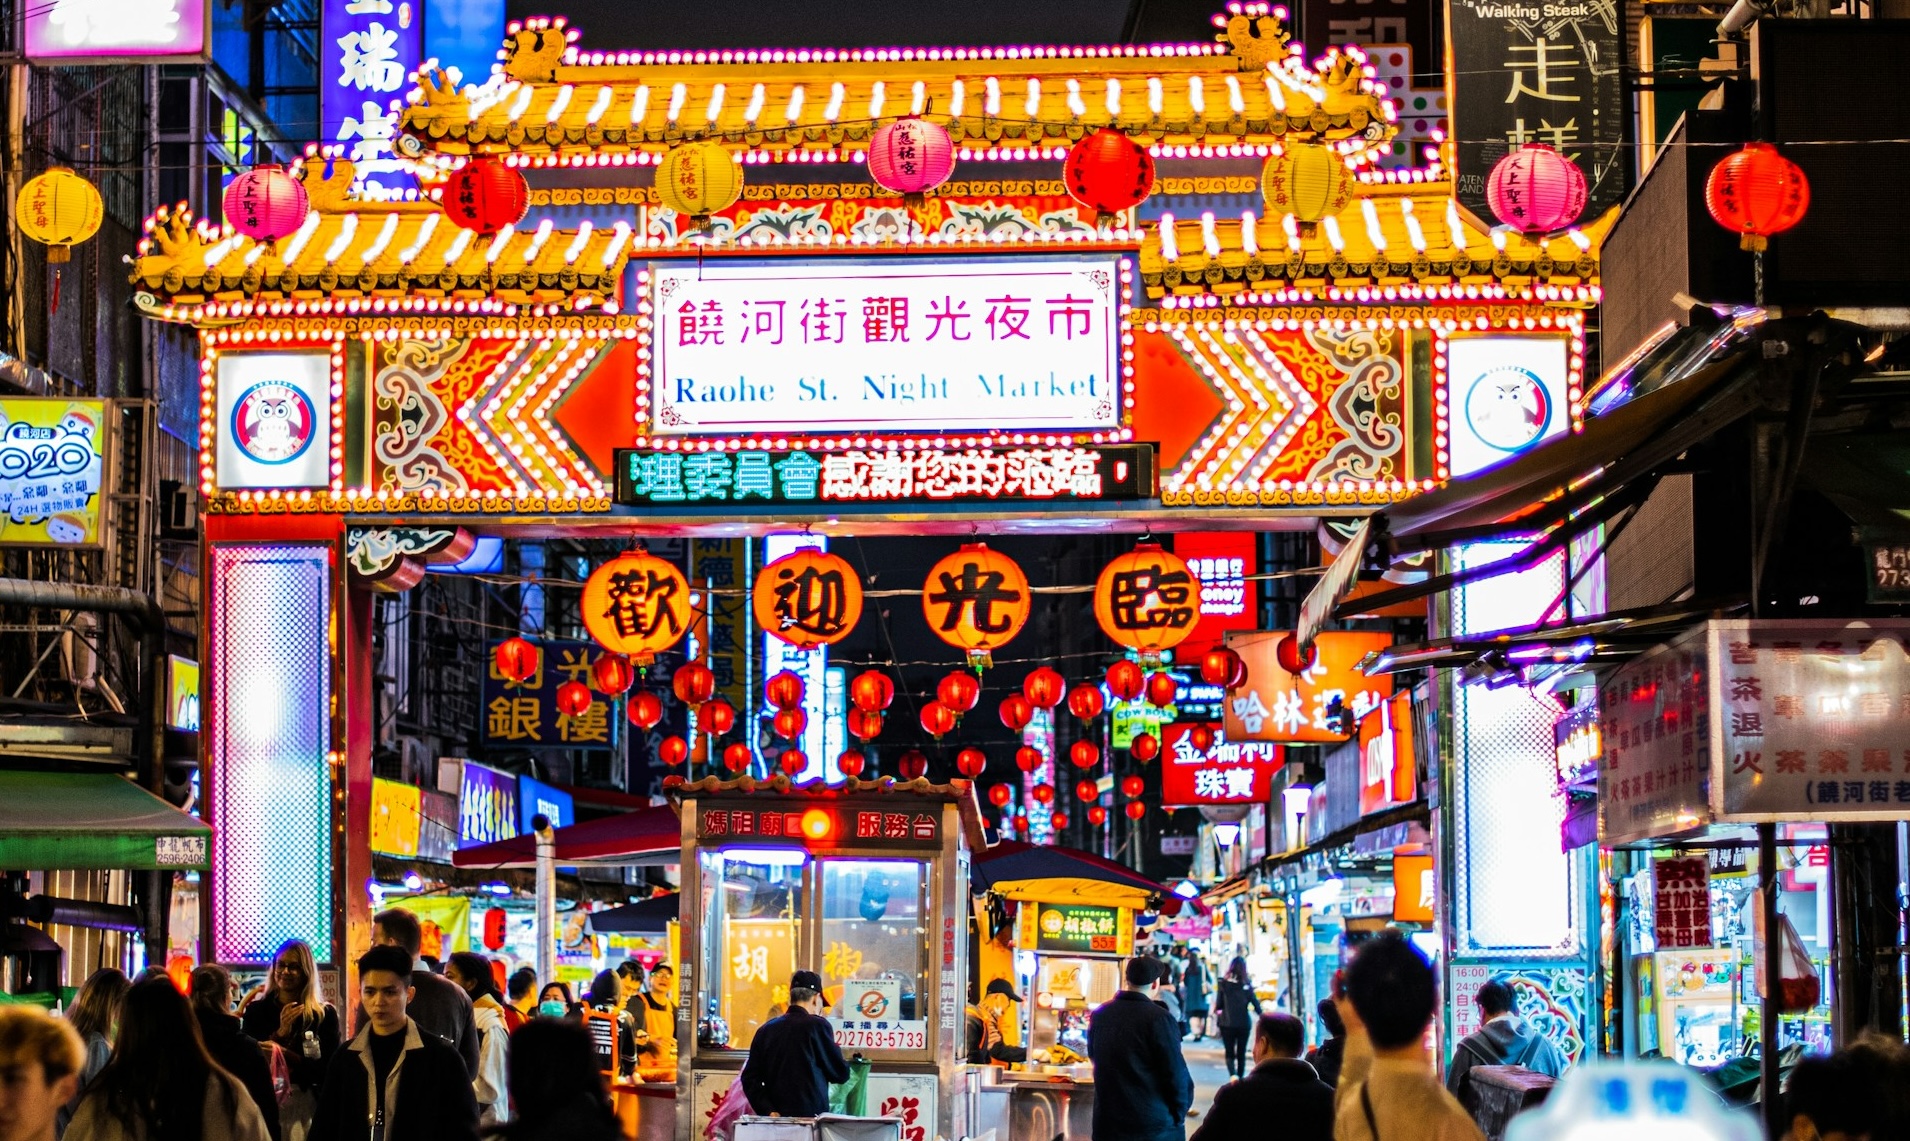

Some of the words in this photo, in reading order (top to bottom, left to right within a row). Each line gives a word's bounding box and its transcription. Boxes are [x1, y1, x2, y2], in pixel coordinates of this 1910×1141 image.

[1476, 4, 1539, 19] Walking
[1544, 4, 1588, 17] Steak
[243, 174, 260, 228] 天上聖母
[1506, 158, 1525, 218] 天上聖母
[678, 293, 1094, 346] 饒河街觀光夜市
[675, 375, 775, 403] Raohe
[799, 375, 838, 401] St.
[863, 374, 948, 405] Night
[977, 371, 1097, 398] Market
[19, 428, 51, 438] 饒河店
[17, 505, 38, 516] 24H
[1875, 549, 1910, 569] 龍門
[602, 569, 683, 640] 歡
[773, 564, 848, 634] 迎
[928, 562, 1022, 635] 光
[1109, 564, 1194, 631] 臨
[1200, 587, 1245, 604] oney
[1116, 709, 1141, 720] COW
[1145, 709, 1175, 720] BOSS
[1729, 640, 1764, 776] 苦茶退火
[1773, 640, 1806, 775] 青草茶
[1194, 767, 1254, 798] 珠寶
[857, 812, 938, 840] 服務台
[1656, 858, 1706, 889] 熱
[732, 943, 769, 986] 胡
[1456, 968, 1485, 977] 16:00
[843, 1021, 904, 1031] 廣播尋人
[1456, 994, 1469, 1036] 自行車
